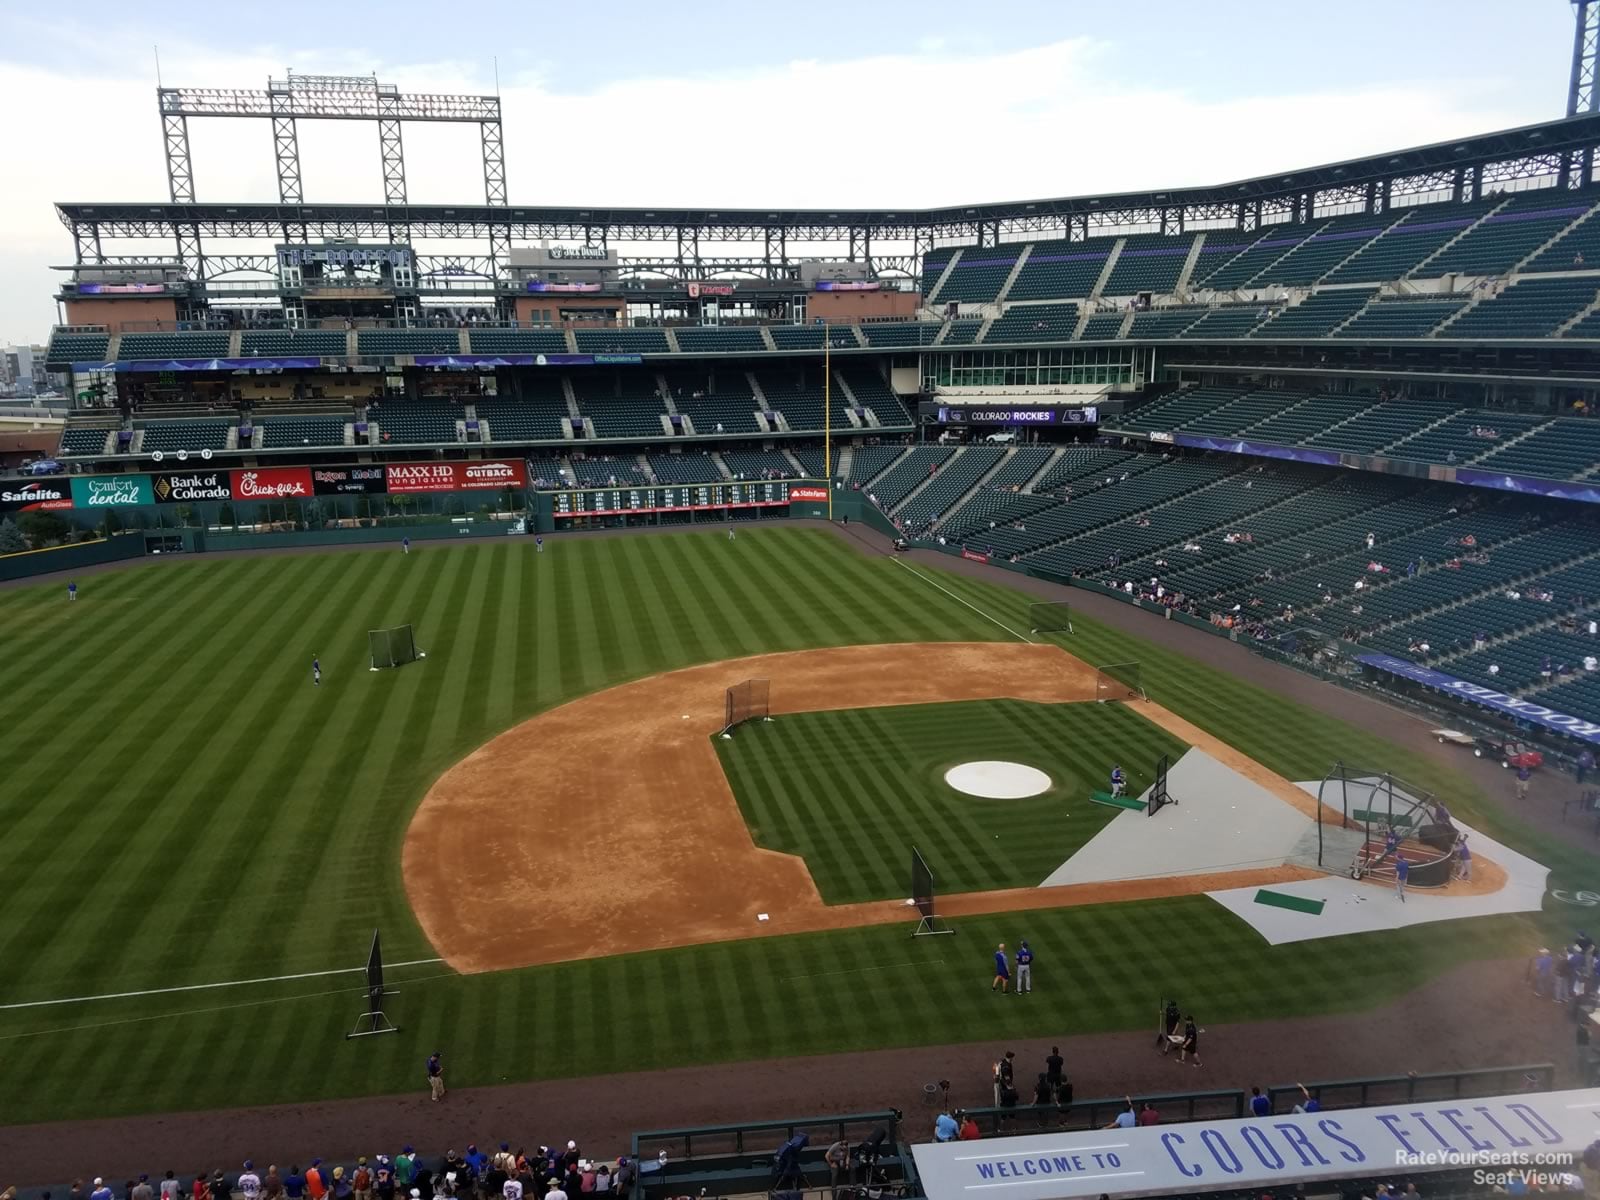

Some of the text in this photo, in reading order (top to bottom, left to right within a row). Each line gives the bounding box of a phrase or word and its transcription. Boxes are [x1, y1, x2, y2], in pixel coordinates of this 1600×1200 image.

[278, 250, 411, 265] THE ROOFTOP
[971, 411, 1050, 421] COLORADO ROCKIES
[315, 469, 382, 483] Exxon Mobil
[388, 465, 453, 478] MAXX HD
[466, 469, 514, 478] OUTBACK
[170, 474, 217, 488] Bank of
[389, 477, 453, 485] sunglasses
[1, 489, 62, 502] Safelite
[89, 487, 140, 505] dental
[172, 486, 230, 500] Colorado
[1160, 1103, 1565, 1178] COORS FIELD
[976, 1152, 1122, 1180] WELCOME TO
